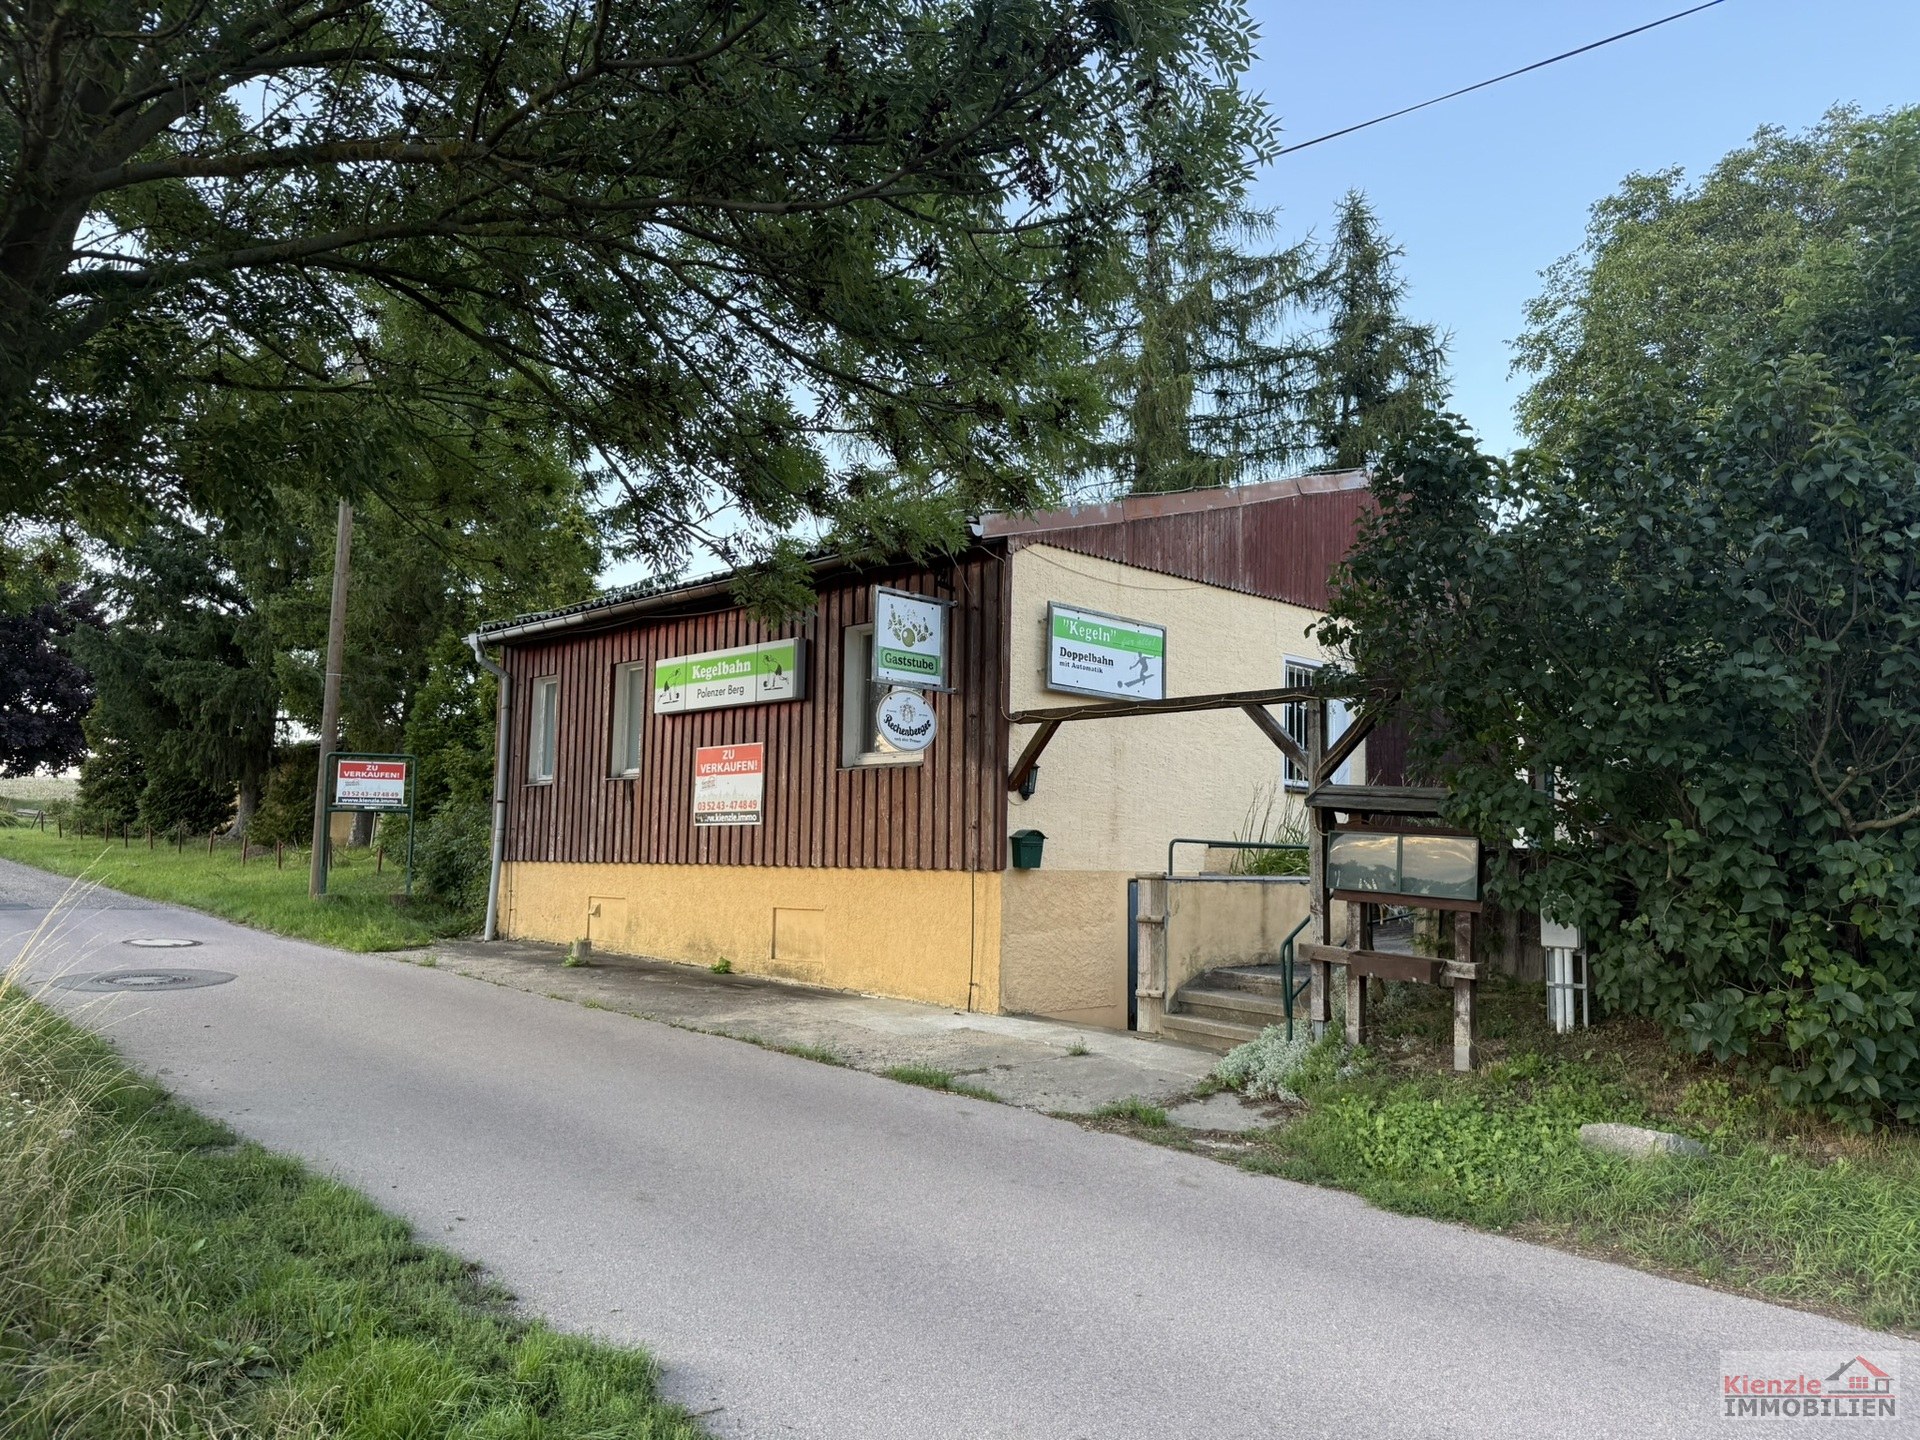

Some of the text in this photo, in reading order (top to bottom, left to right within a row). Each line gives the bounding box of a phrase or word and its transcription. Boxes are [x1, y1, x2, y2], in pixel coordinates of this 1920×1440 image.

[885, 652, 934, 670] Gaststube
[1060, 646, 1114, 666] Doppelbahn
[692, 659, 751, 680] Kegelbahn
[1071, 662, 1104, 674] Automatik
[697, 684, 745, 699] Polenzer Berg
[884, 714, 931, 736] Rechenberger
[722, 749, 735, 760] ZU
[343, 770, 400, 778] VERKAUFEN!
[700, 760, 758, 773] VERKAUFEN!
